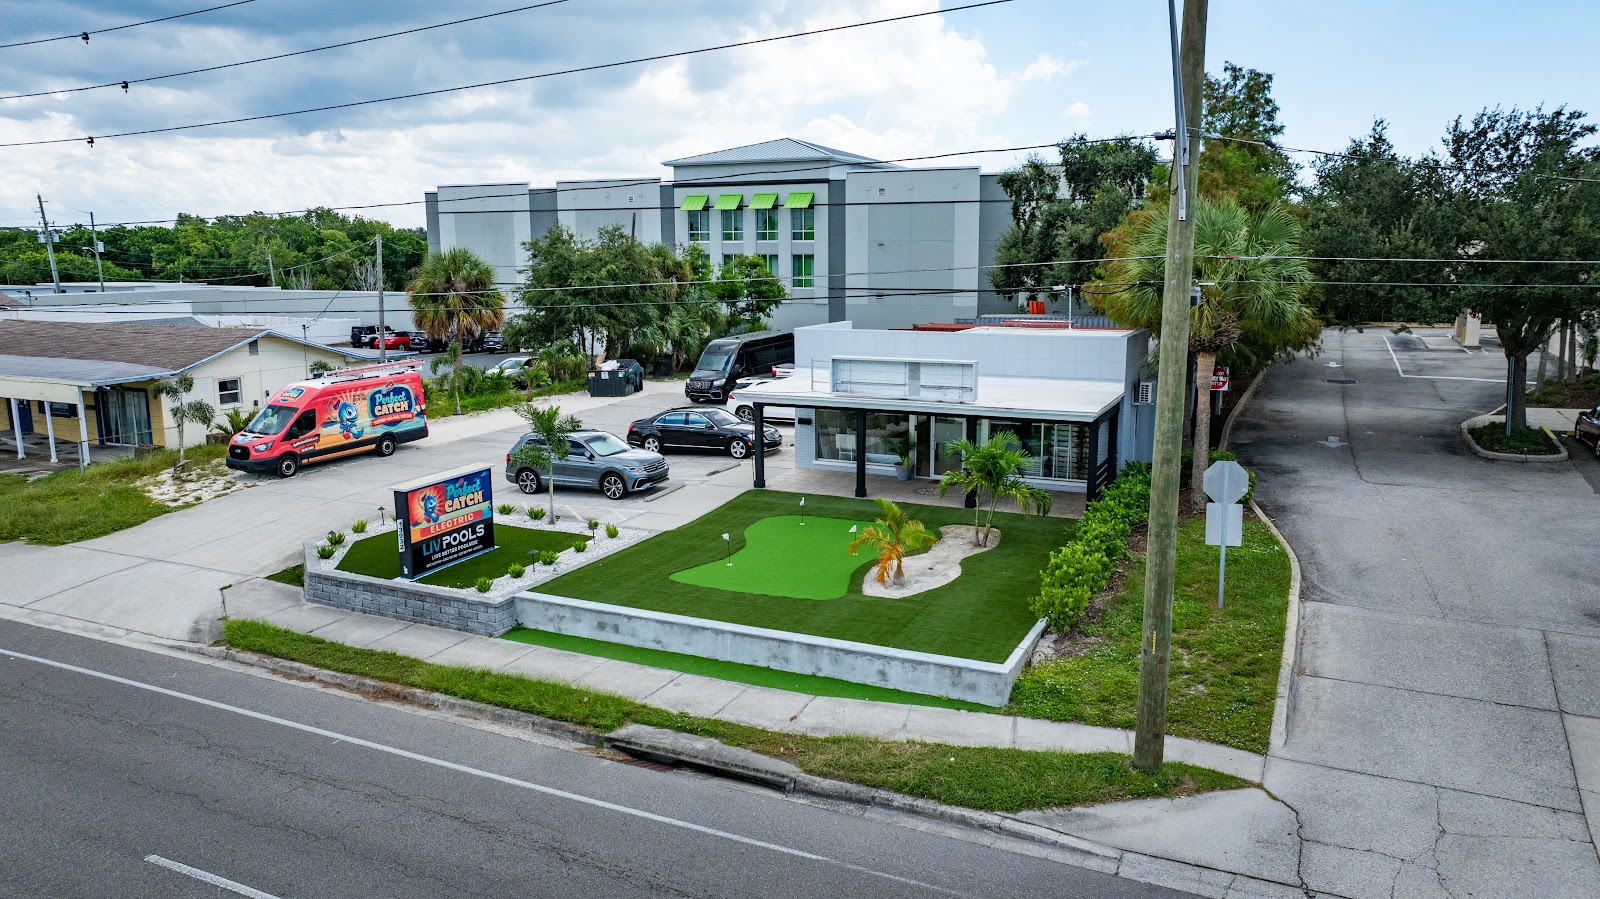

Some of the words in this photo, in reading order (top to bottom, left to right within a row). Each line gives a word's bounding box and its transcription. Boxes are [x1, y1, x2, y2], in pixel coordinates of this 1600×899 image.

[374, 391, 407, 405] Perfect
[374, 401, 408, 416] CATCH
[446, 478, 481, 500] Perfect
[444, 490, 483, 512] CATCH
[430, 513, 474, 534] ELECTRIC
